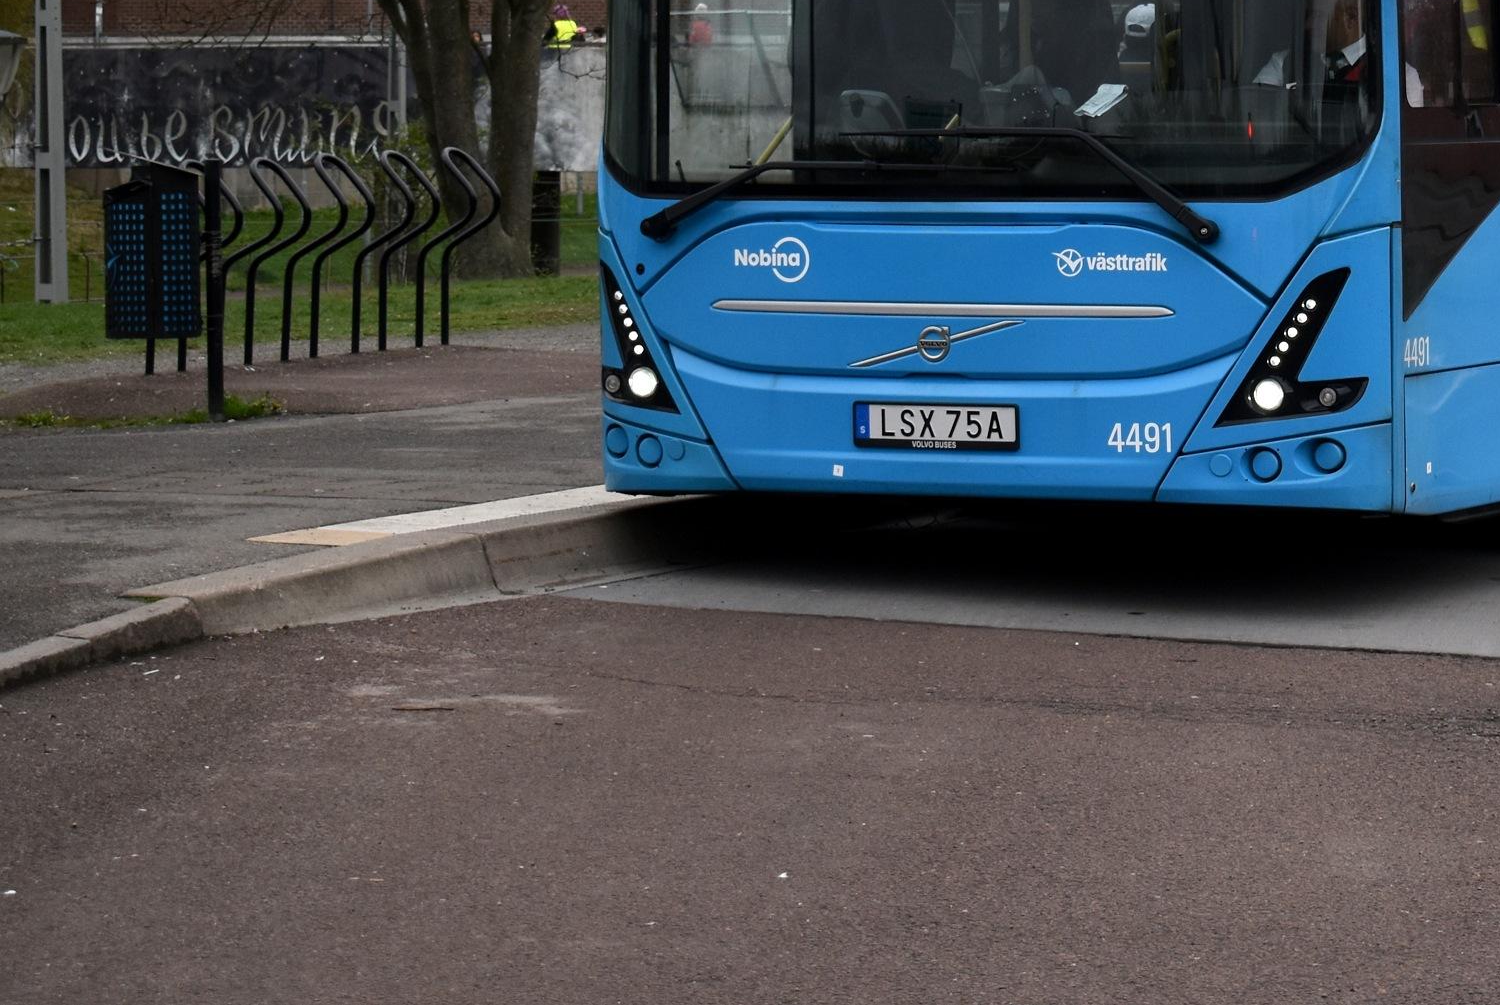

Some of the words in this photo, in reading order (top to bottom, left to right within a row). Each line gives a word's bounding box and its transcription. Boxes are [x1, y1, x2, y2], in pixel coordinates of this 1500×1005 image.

[734, 247, 801, 268] Nobina
[1087, 252, 1168, 273] västtrafik
[1403, 336, 1430, 368] 4491
[881, 408, 936, 438] LSX
[946, 409, 1004, 439] 75A
[911, 440, 934, 449] VOLVO
[934, 441, 957, 449] BUSES
[1107, 422, 1173, 453] 4491
